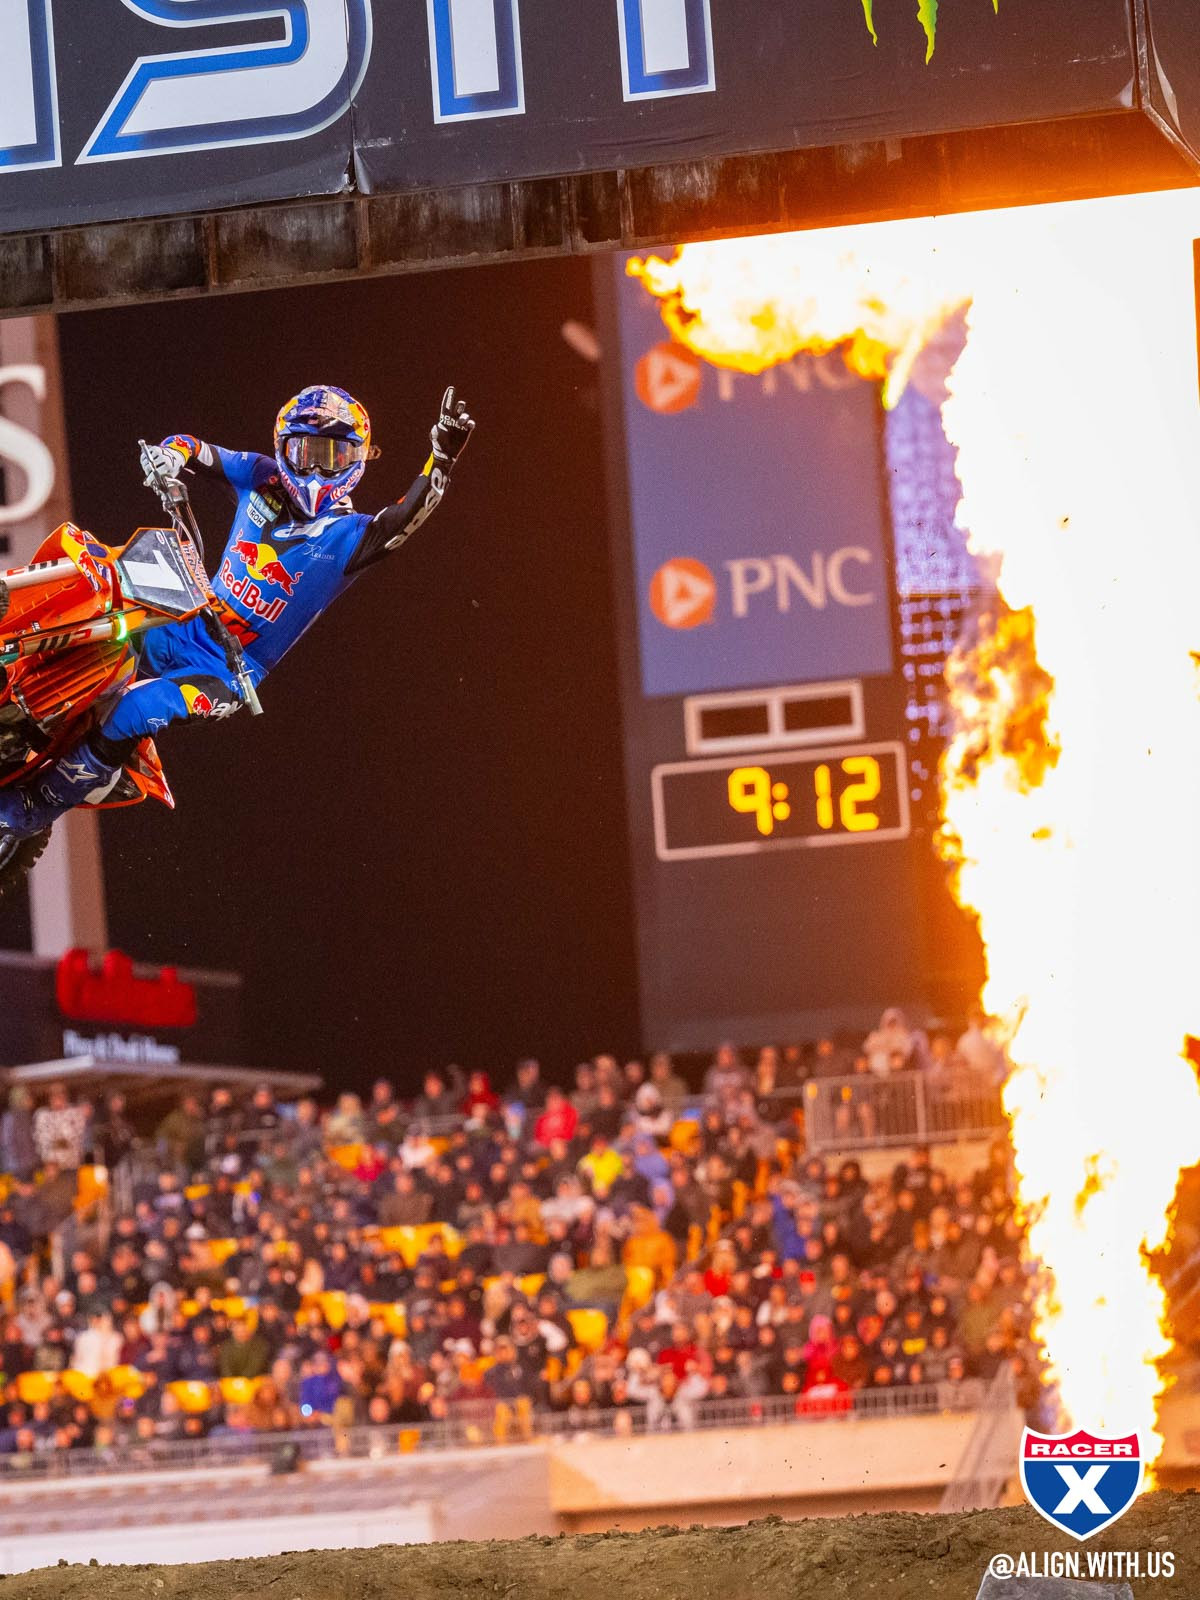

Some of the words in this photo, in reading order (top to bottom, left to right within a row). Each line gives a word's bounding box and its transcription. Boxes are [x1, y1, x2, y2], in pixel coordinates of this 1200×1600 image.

[122, 549, 186, 592] 1
[727, 547, 877, 618] PNC
[728, 757, 881, 835] 9:12
